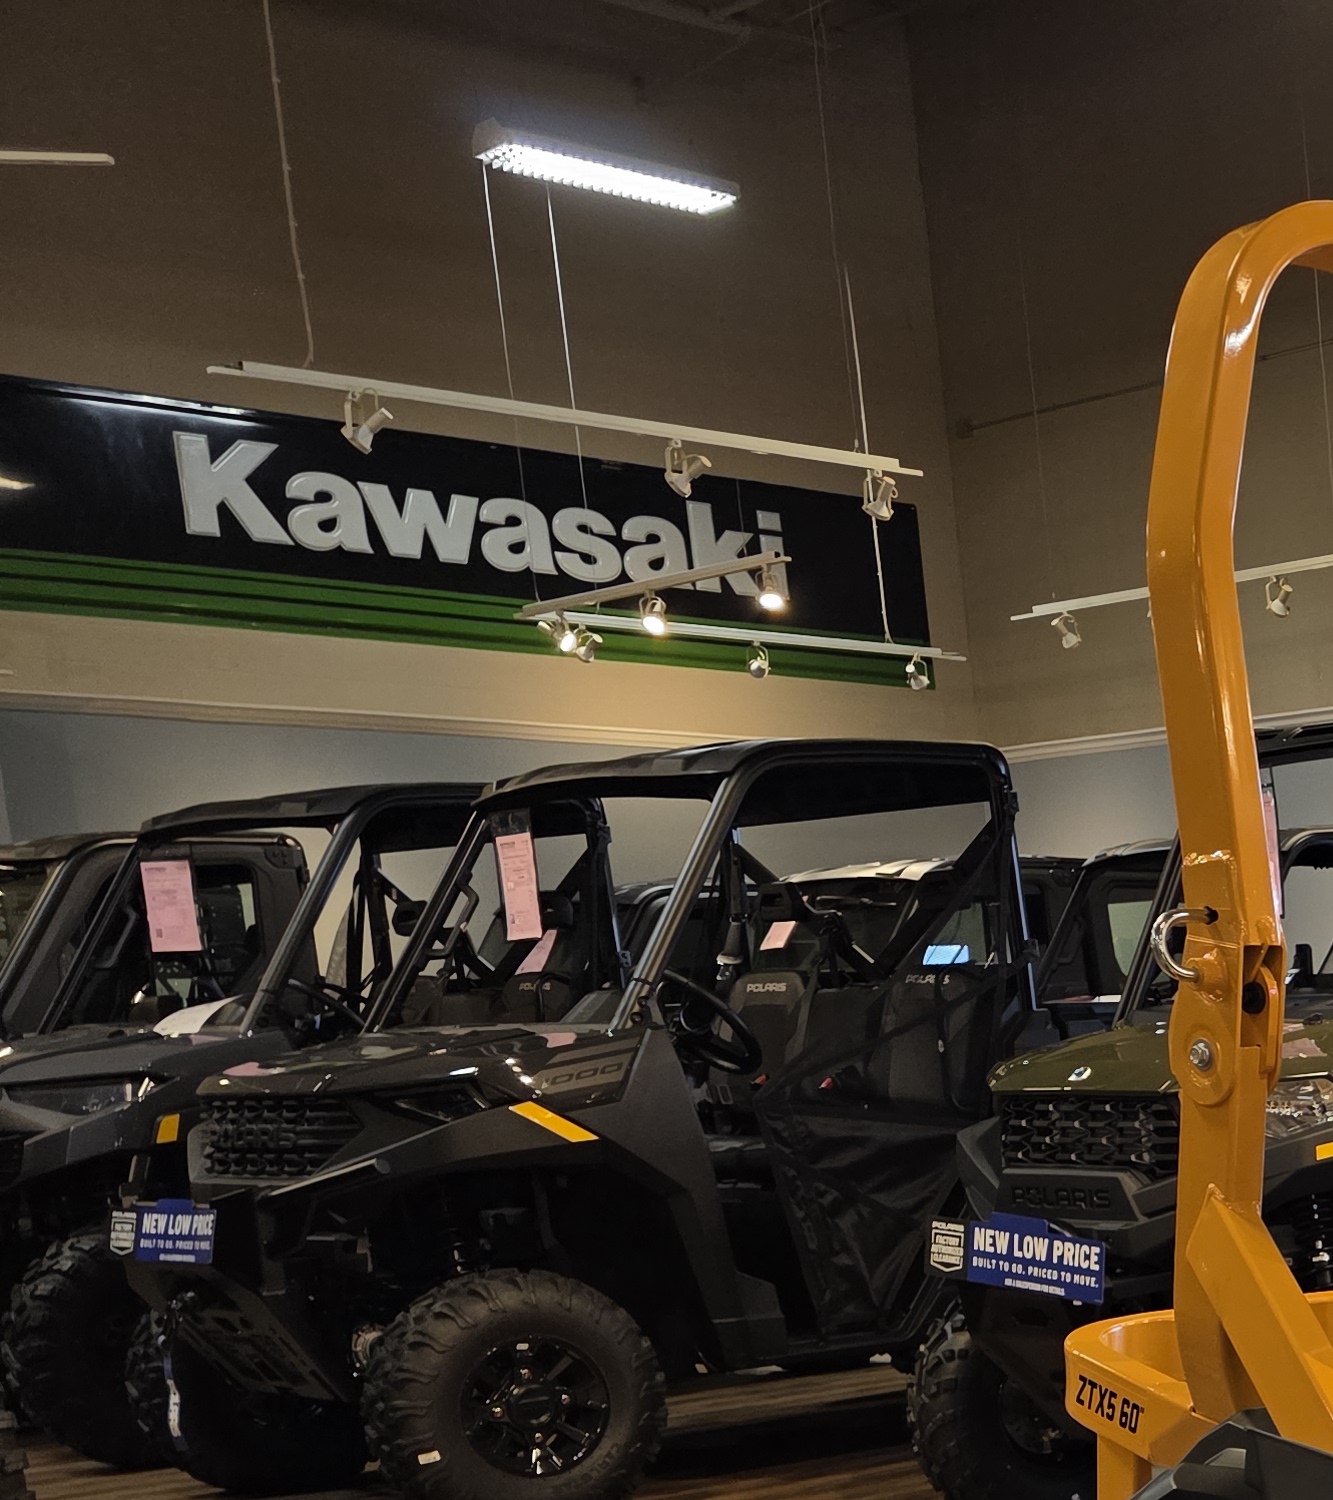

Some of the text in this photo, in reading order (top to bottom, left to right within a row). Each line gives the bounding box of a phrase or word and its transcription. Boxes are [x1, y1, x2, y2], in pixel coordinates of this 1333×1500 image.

[172, 430, 789, 602] Kawasaki
[746, 982, 787, 993] POLARIS
[1011, 1186, 1111, 1209] POLARIS
[142, 1212, 167, 1235] NEW
[168, 1214, 192, 1236] LOW
[973, 1227, 1101, 1271] NEW LOW PRICE
[972, 1256, 997, 1270] BUILT
[999, 1260, 1009, 1272] TO
[1028, 1265, 1058, 1281] PRICED
[1060, 1271, 1071, 1283] TO
[1073, 1274, 1099, 1288] MOVE.
[1076, 1374, 1118, 1422] ZTX5
